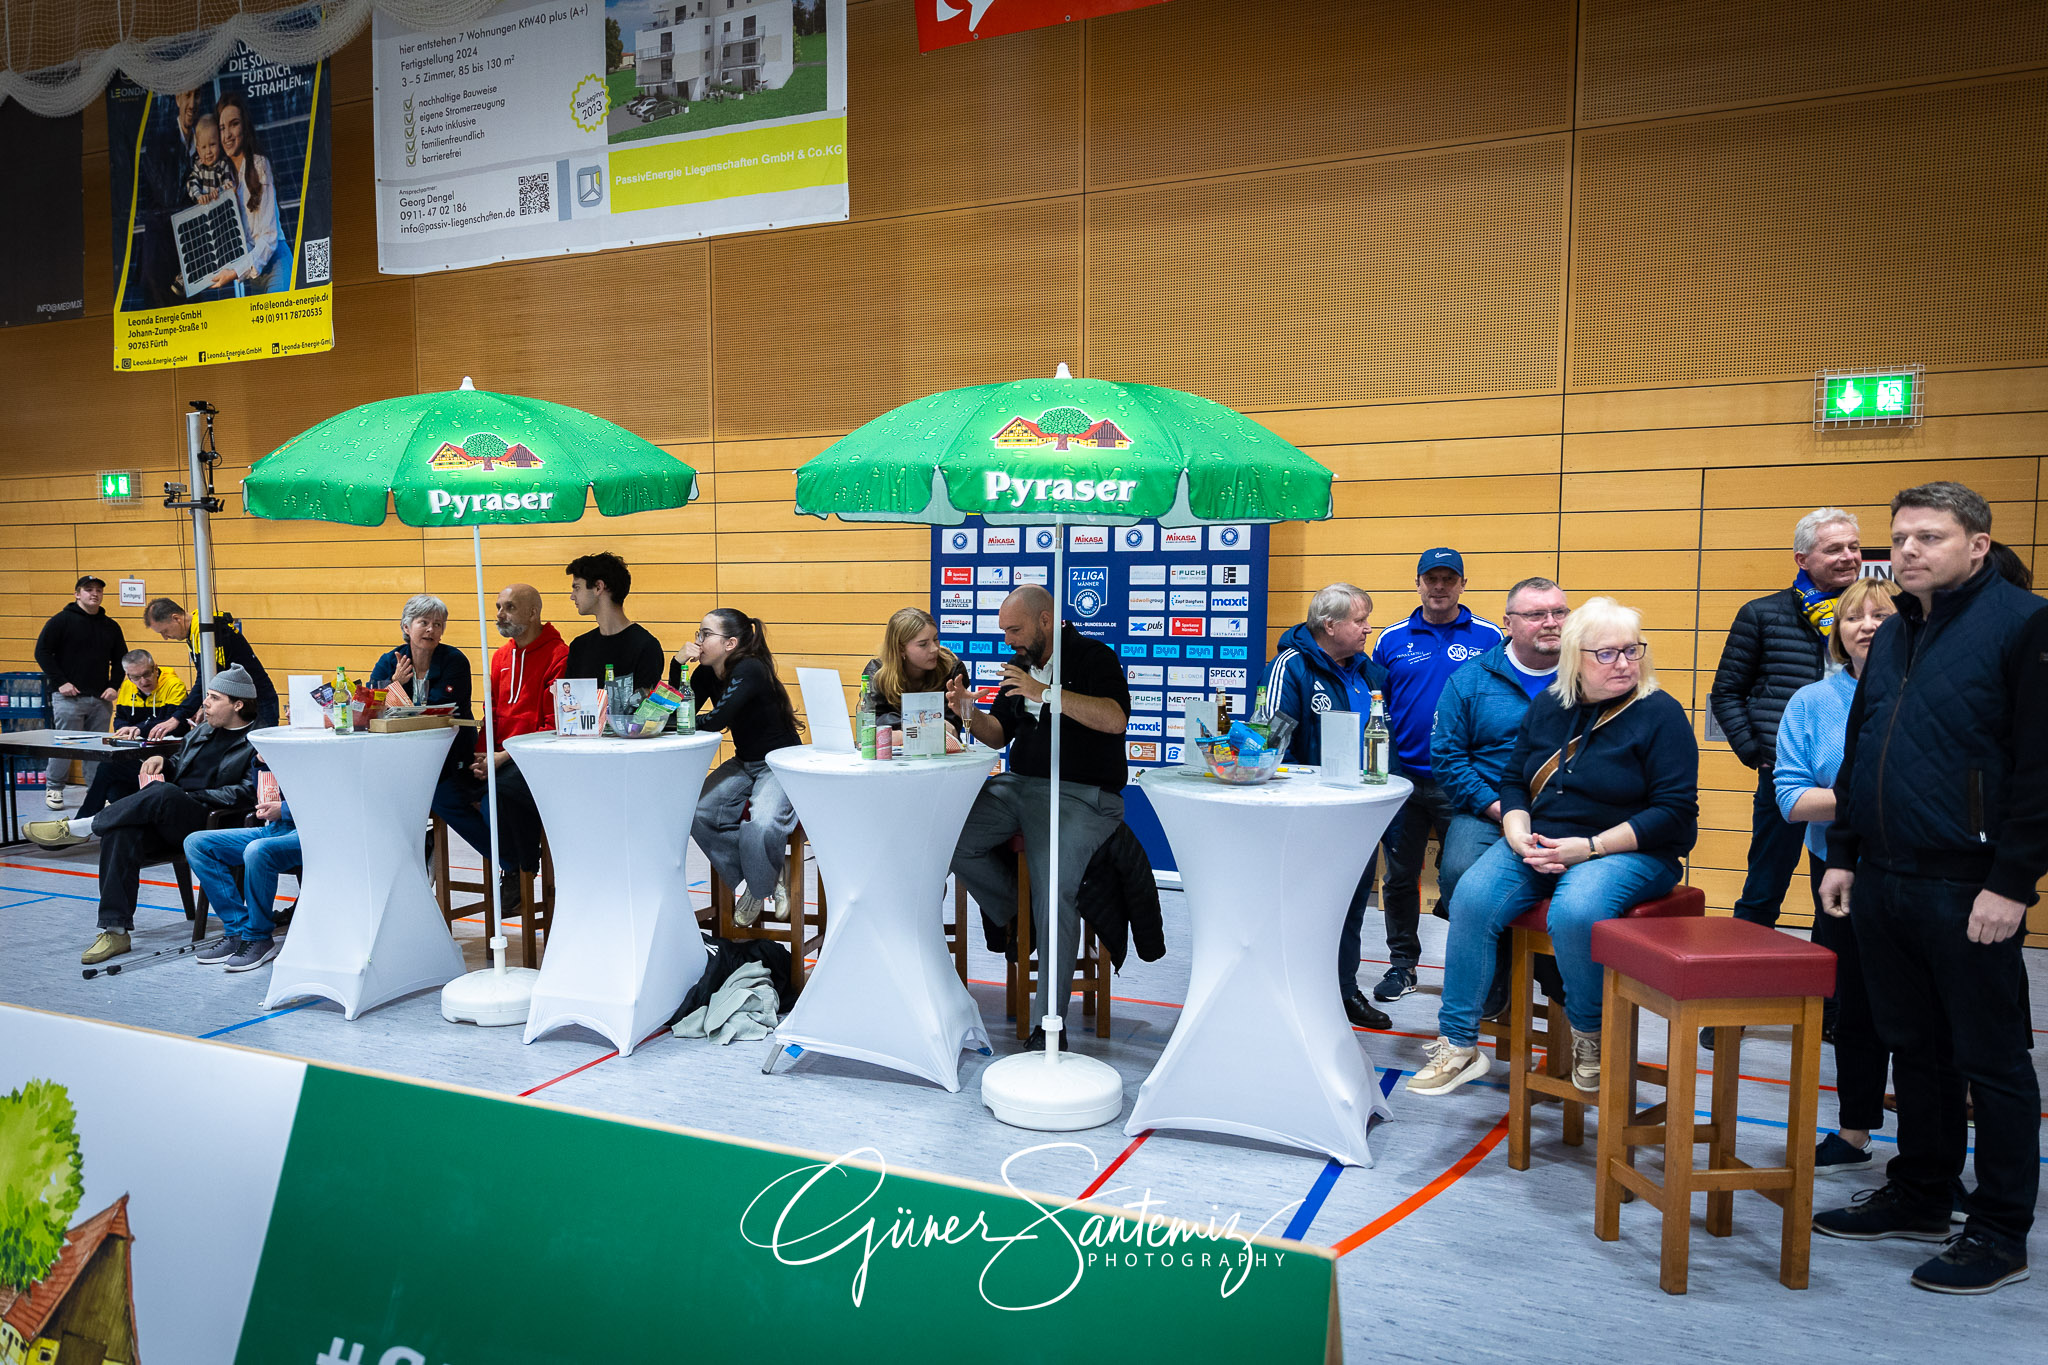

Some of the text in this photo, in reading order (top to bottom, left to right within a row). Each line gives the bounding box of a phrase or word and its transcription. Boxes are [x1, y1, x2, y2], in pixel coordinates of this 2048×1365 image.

[399, 3, 589, 55] hier entstehen 7 Wohnungen KfW40 plus (A+)
[229, 55, 248, 72] DIE
[401, 47, 478, 71] Fertigstellung 2024
[242, 63, 292, 85] FÜR DICH
[402, 78, 408, 88] 3
[415, 75, 421, 84] 5
[424, 70, 456, 83] Zimmer,
[458, 66, 470, 76] 85
[472, 62, 484, 73] bis
[486, 58, 502, 70] 130
[111, 87, 147, 98] LEONDA
[418, 85, 498, 108] nachhaltige Bauweise
[576, 90, 605, 109] Baubeginn
[420, 98, 505, 122] eigene Stromerzeugung
[582, 101, 604, 120] 2023
[420, 117, 477, 136] E-Auto inklusive
[421, 131, 485, 150] familienfreundlich
[422, 150, 462, 164] barrierefrei
[616, 144, 842, 186] PassivEnergie Liegenschaften GmbH & Co.KG
[400, 191, 455, 208] Georg Dengel
[428, 207, 437, 217] 47
[439, 206, 450, 216] 02
[452, 203, 467, 214] 186
[400, 208, 516, 234] info@passiv-liegenschaften.de
[128, 310, 202, 326] Leonda Energie GmbH
[251, 307, 322, 324] +49 (0) 911 78720535
[128, 322, 208, 338] Johann-Zumpe-Straße 10
[128, 339, 168, 350] 90763 Fürth
[986, 471, 1138, 508] Pyraser
[428, 490, 554, 519] Pyraser
[1212, 596, 1248, 606] maxit
[1210, 669, 1236, 678] SPECK
[580, 714, 596, 730] VIP
[1127, 722, 1160, 732] maxit
[906, 726, 918, 738] VIP
